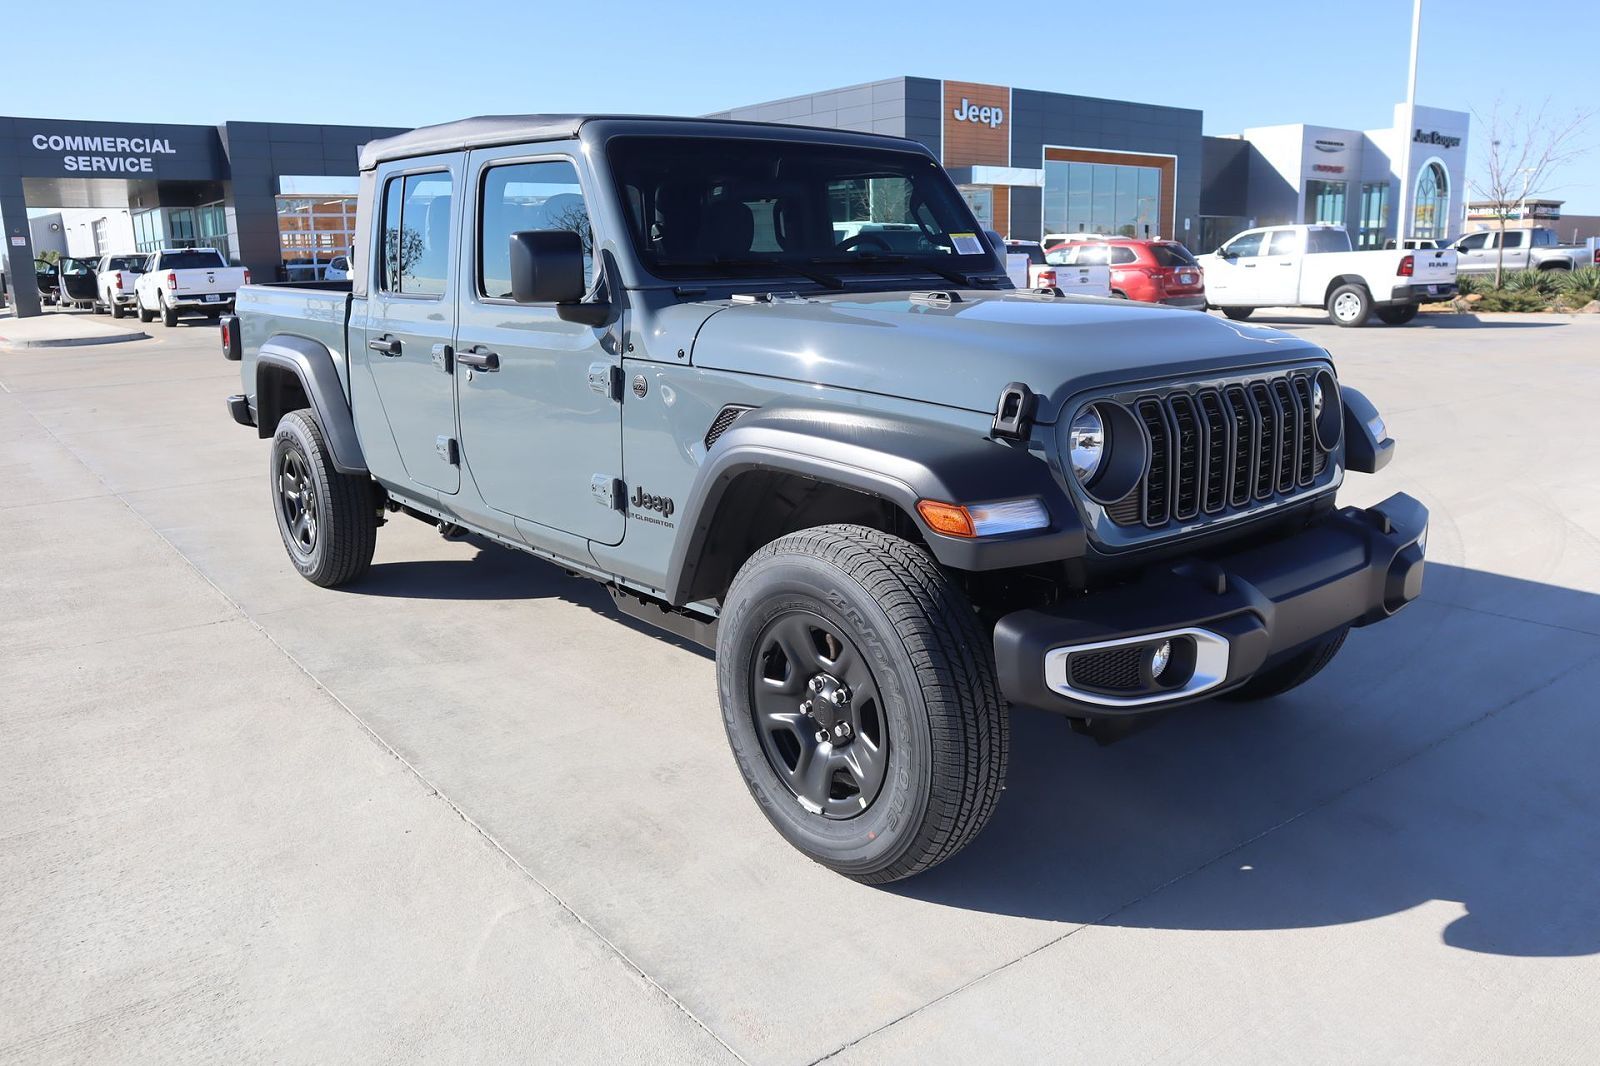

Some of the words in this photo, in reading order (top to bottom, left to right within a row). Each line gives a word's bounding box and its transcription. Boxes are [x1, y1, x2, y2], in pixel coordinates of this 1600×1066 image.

[953, 97, 1003, 128] Jeep
[32, 134, 176, 154] COMMERCIAL
[63, 155, 153, 172] SERVICE
[631, 485, 675, 519] Jeep
[635, 513, 675, 529] GLADIATOR
[828, 588, 912, 832] BRIDGESTONE
